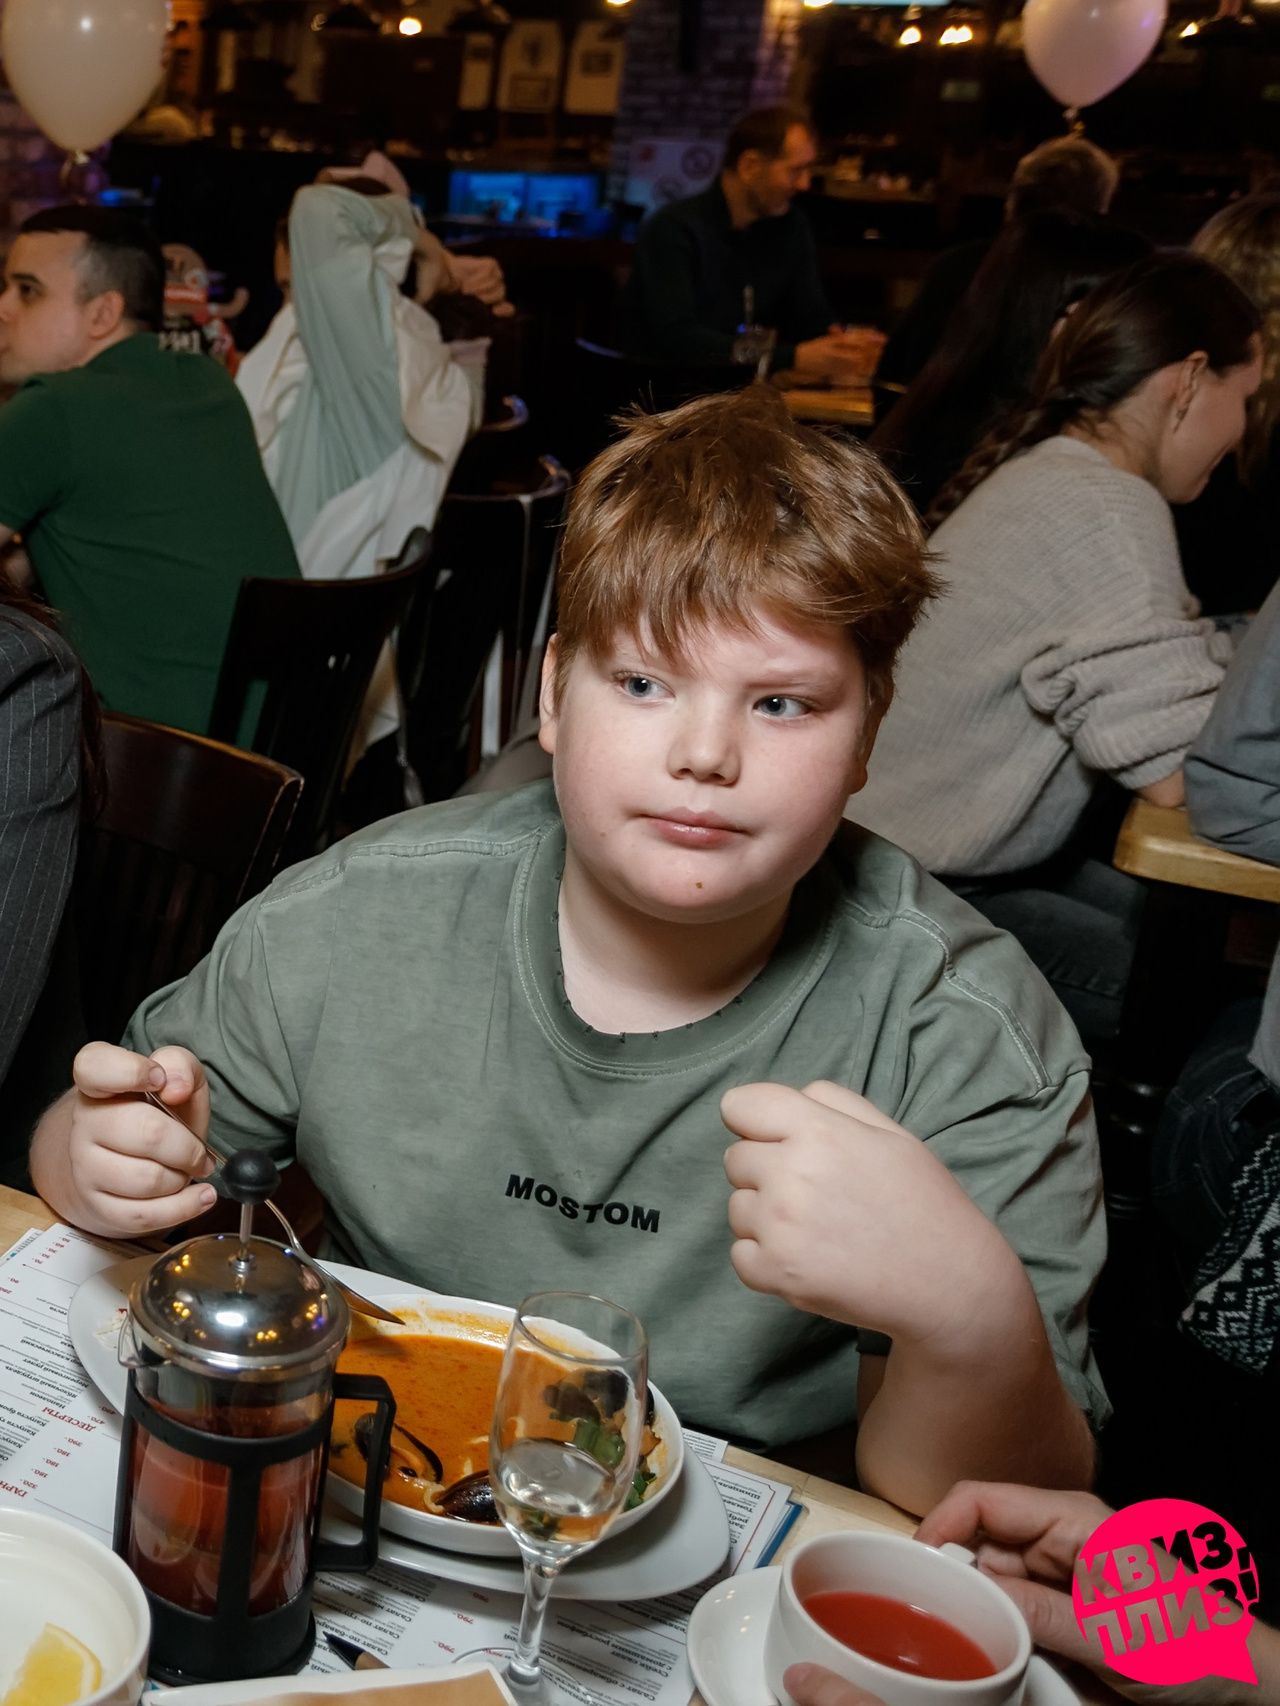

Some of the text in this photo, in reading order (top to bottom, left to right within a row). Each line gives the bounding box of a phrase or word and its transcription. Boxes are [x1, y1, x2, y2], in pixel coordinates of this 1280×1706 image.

[505, 1174, 661, 1233] MOSTOM
[37, 1380, 79, 1398] Яблочный
[26, 1390, 68, 1409] Наполеон
[15, 1411, 47, 1426] Капуста
[40, 1405, 96, 1432] ДЕСЕРТЫ
[5, 1420, 37, 1435] Капуста
[385, 1606, 412, 1622] Салат
[452, 1611, 474, 1624] 790.-
[371, 1623, 400, 1639] Салат
[359, 1639, 389, 1656] Салат
[433, 1640, 455, 1653] 790.-
[609, 1649, 669, 1678] Стейк салат
